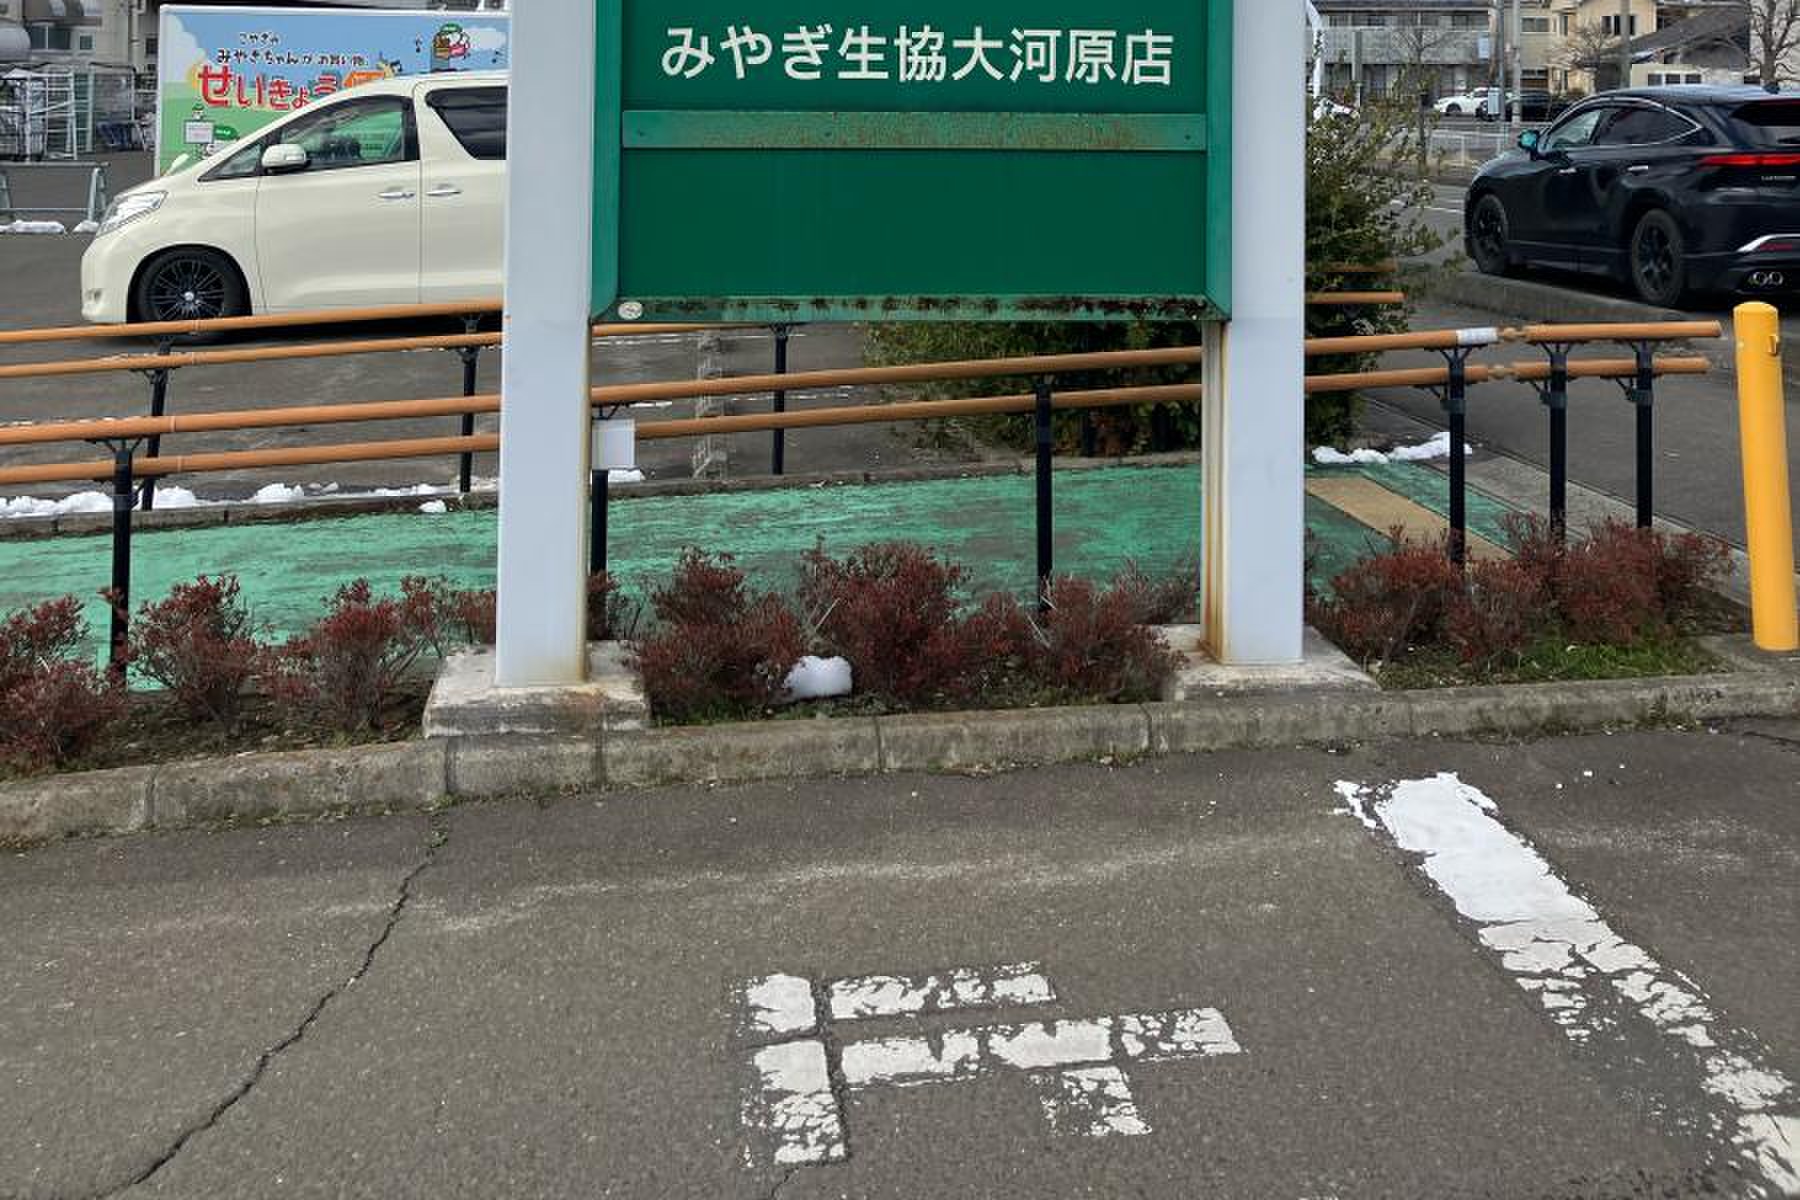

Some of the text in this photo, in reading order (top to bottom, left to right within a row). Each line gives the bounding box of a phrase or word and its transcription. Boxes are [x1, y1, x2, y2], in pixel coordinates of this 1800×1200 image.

[662, 24, 1174, 85] みやぎ生協大河原店
